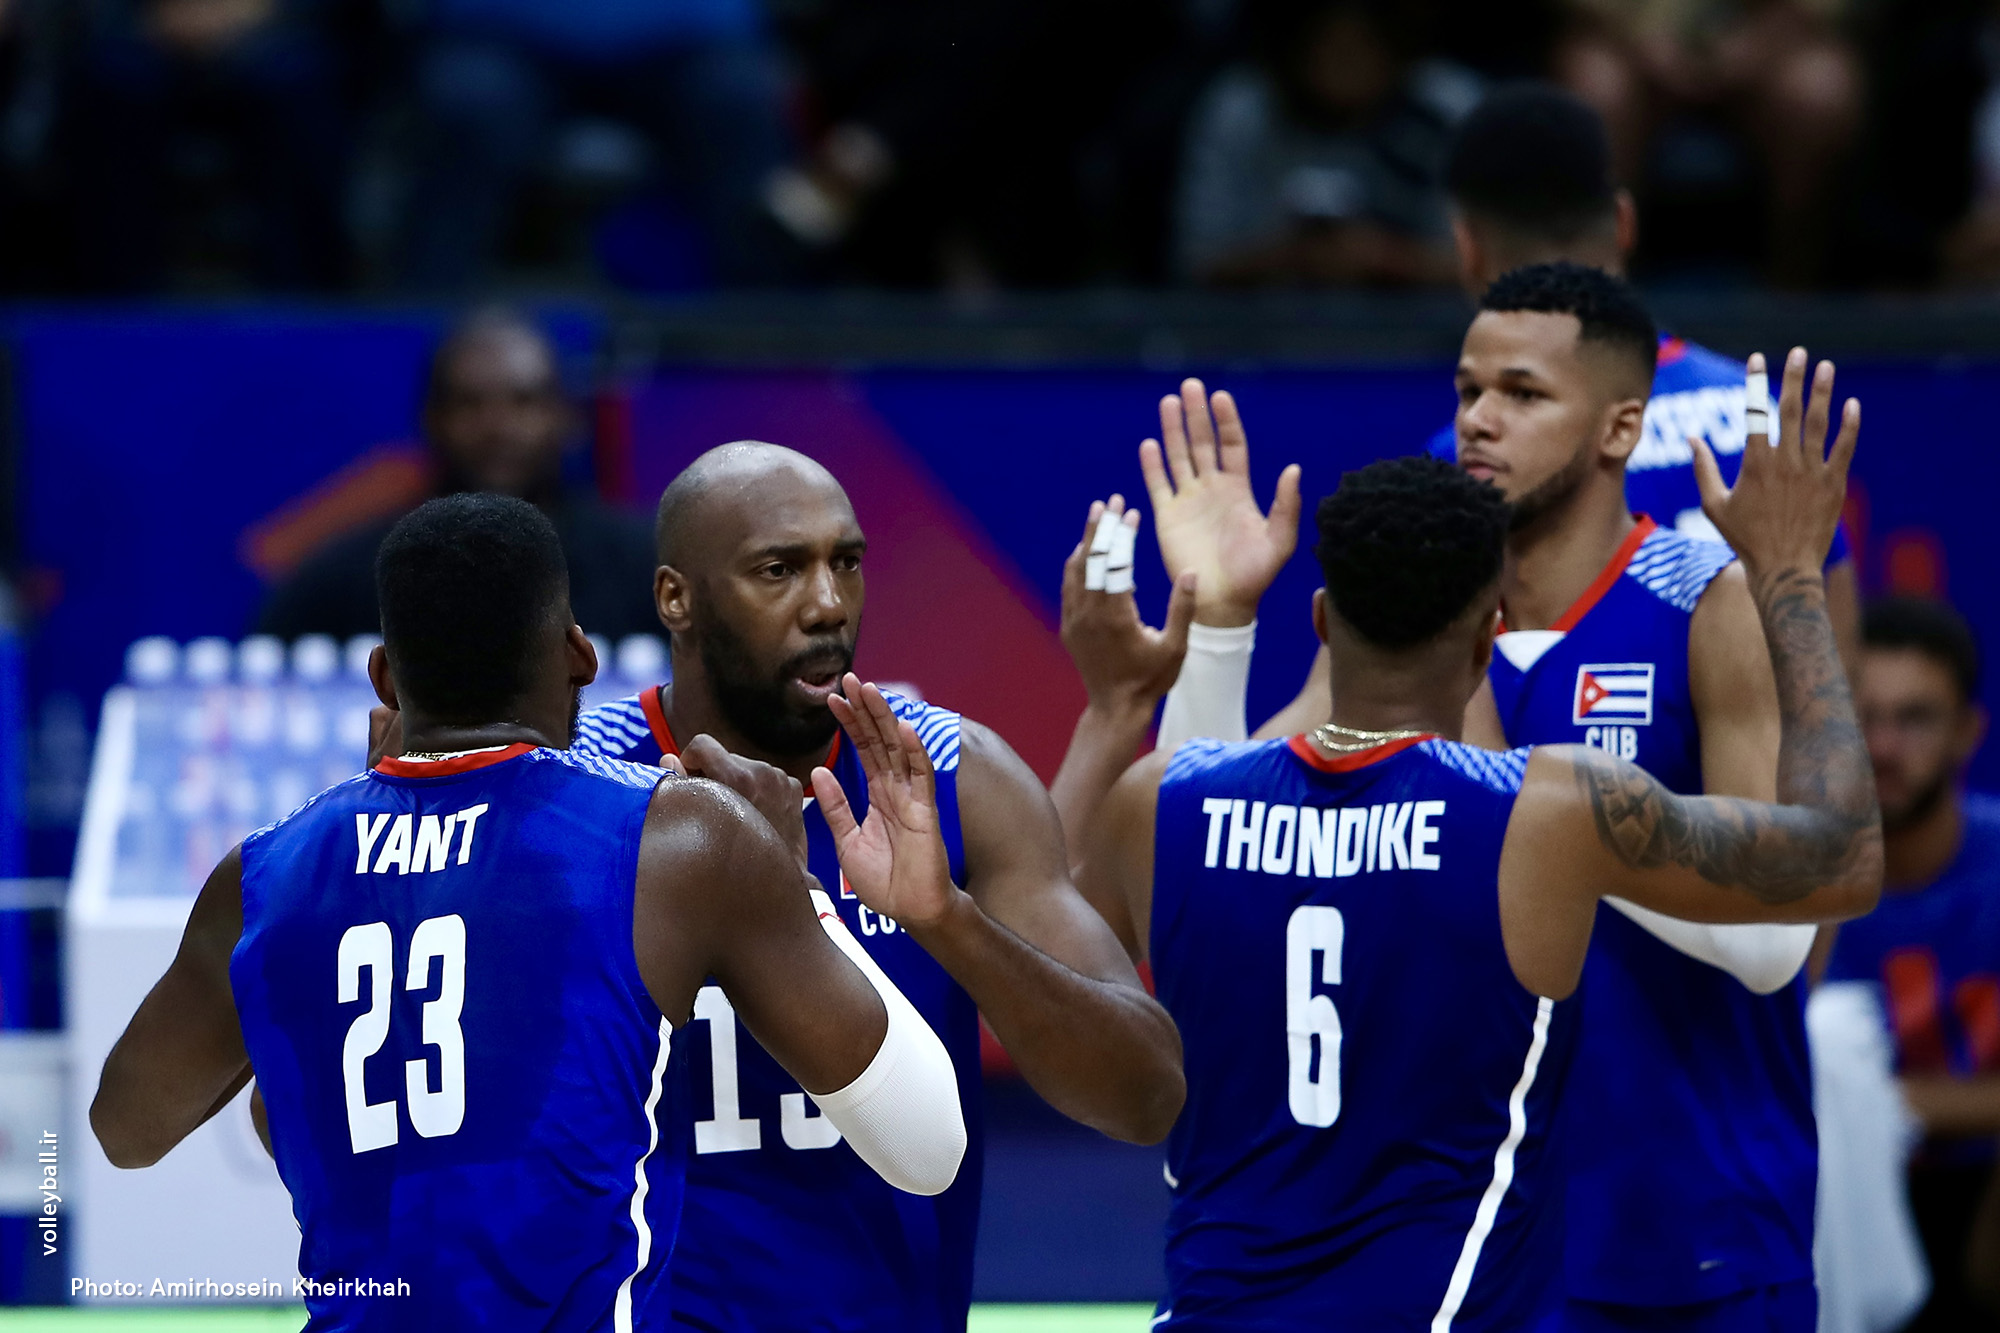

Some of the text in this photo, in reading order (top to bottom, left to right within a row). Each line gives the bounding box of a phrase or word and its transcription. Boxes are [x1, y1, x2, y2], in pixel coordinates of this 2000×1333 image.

[355, 803, 489, 875] YANT
[1202, 798, 1446, 878] THONDIKE
[858, 903, 906, 936] CU
[338, 913, 467, 1155] 23
[1286, 905, 1345, 1128] 6
